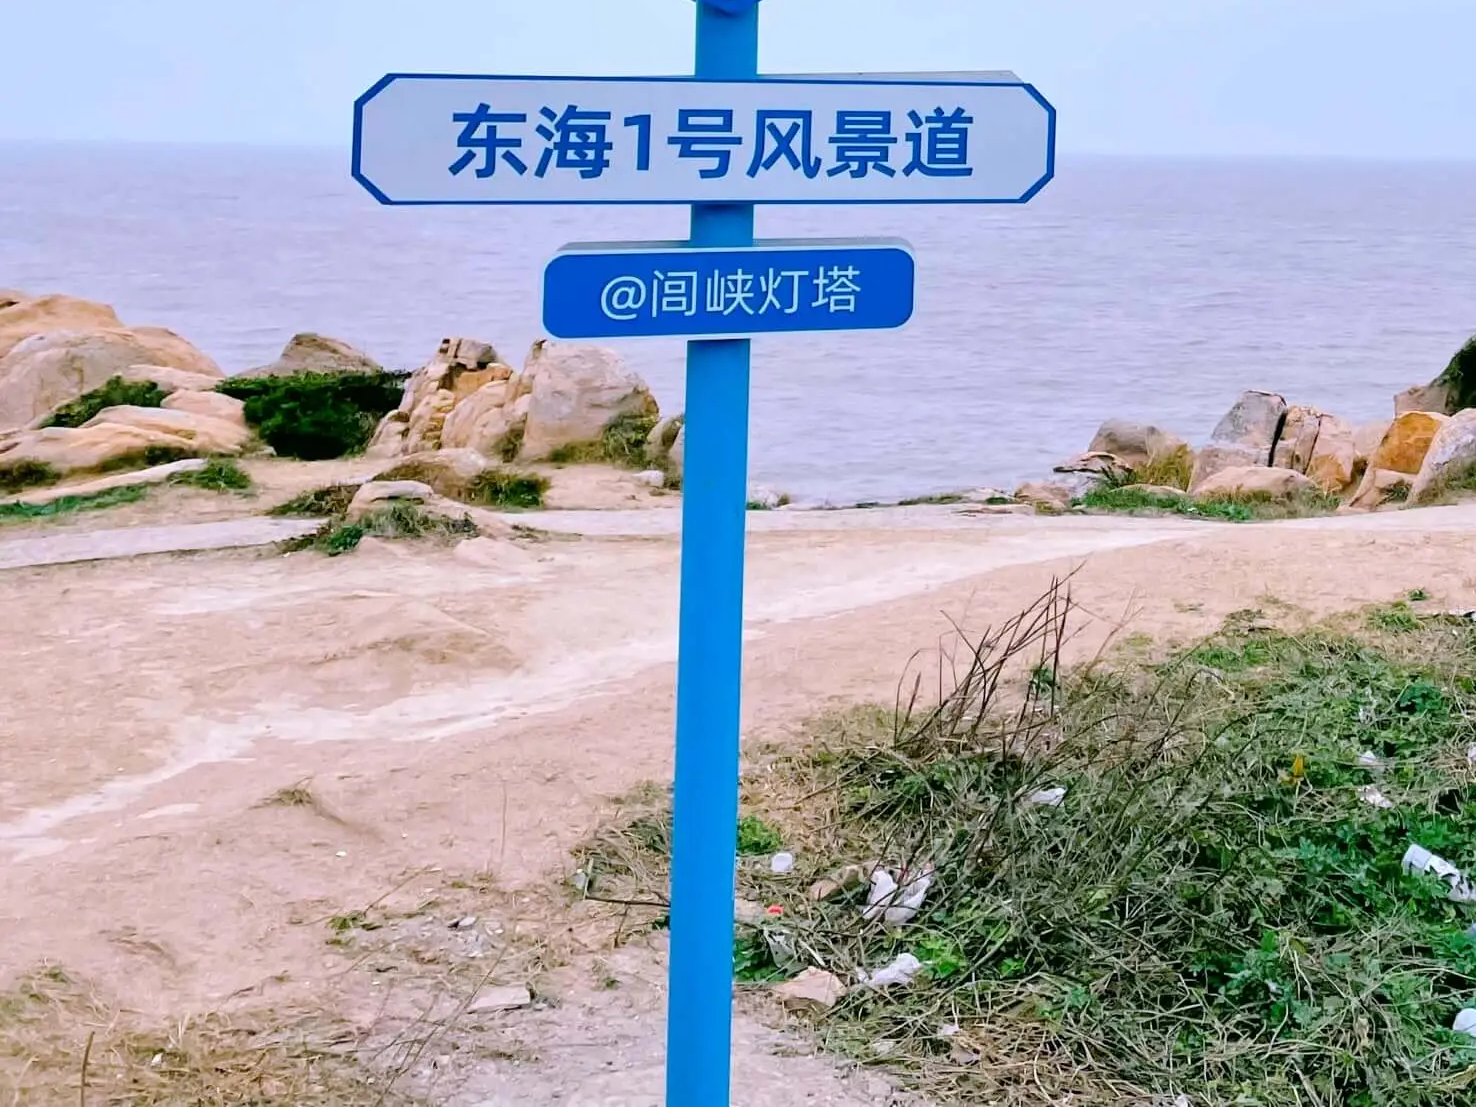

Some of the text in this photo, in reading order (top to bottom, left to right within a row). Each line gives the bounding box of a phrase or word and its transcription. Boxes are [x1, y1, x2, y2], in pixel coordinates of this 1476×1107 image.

[448, 103, 975, 180] 东海1号风景道
[600, 265, 861, 320] @闾峡灯塔
